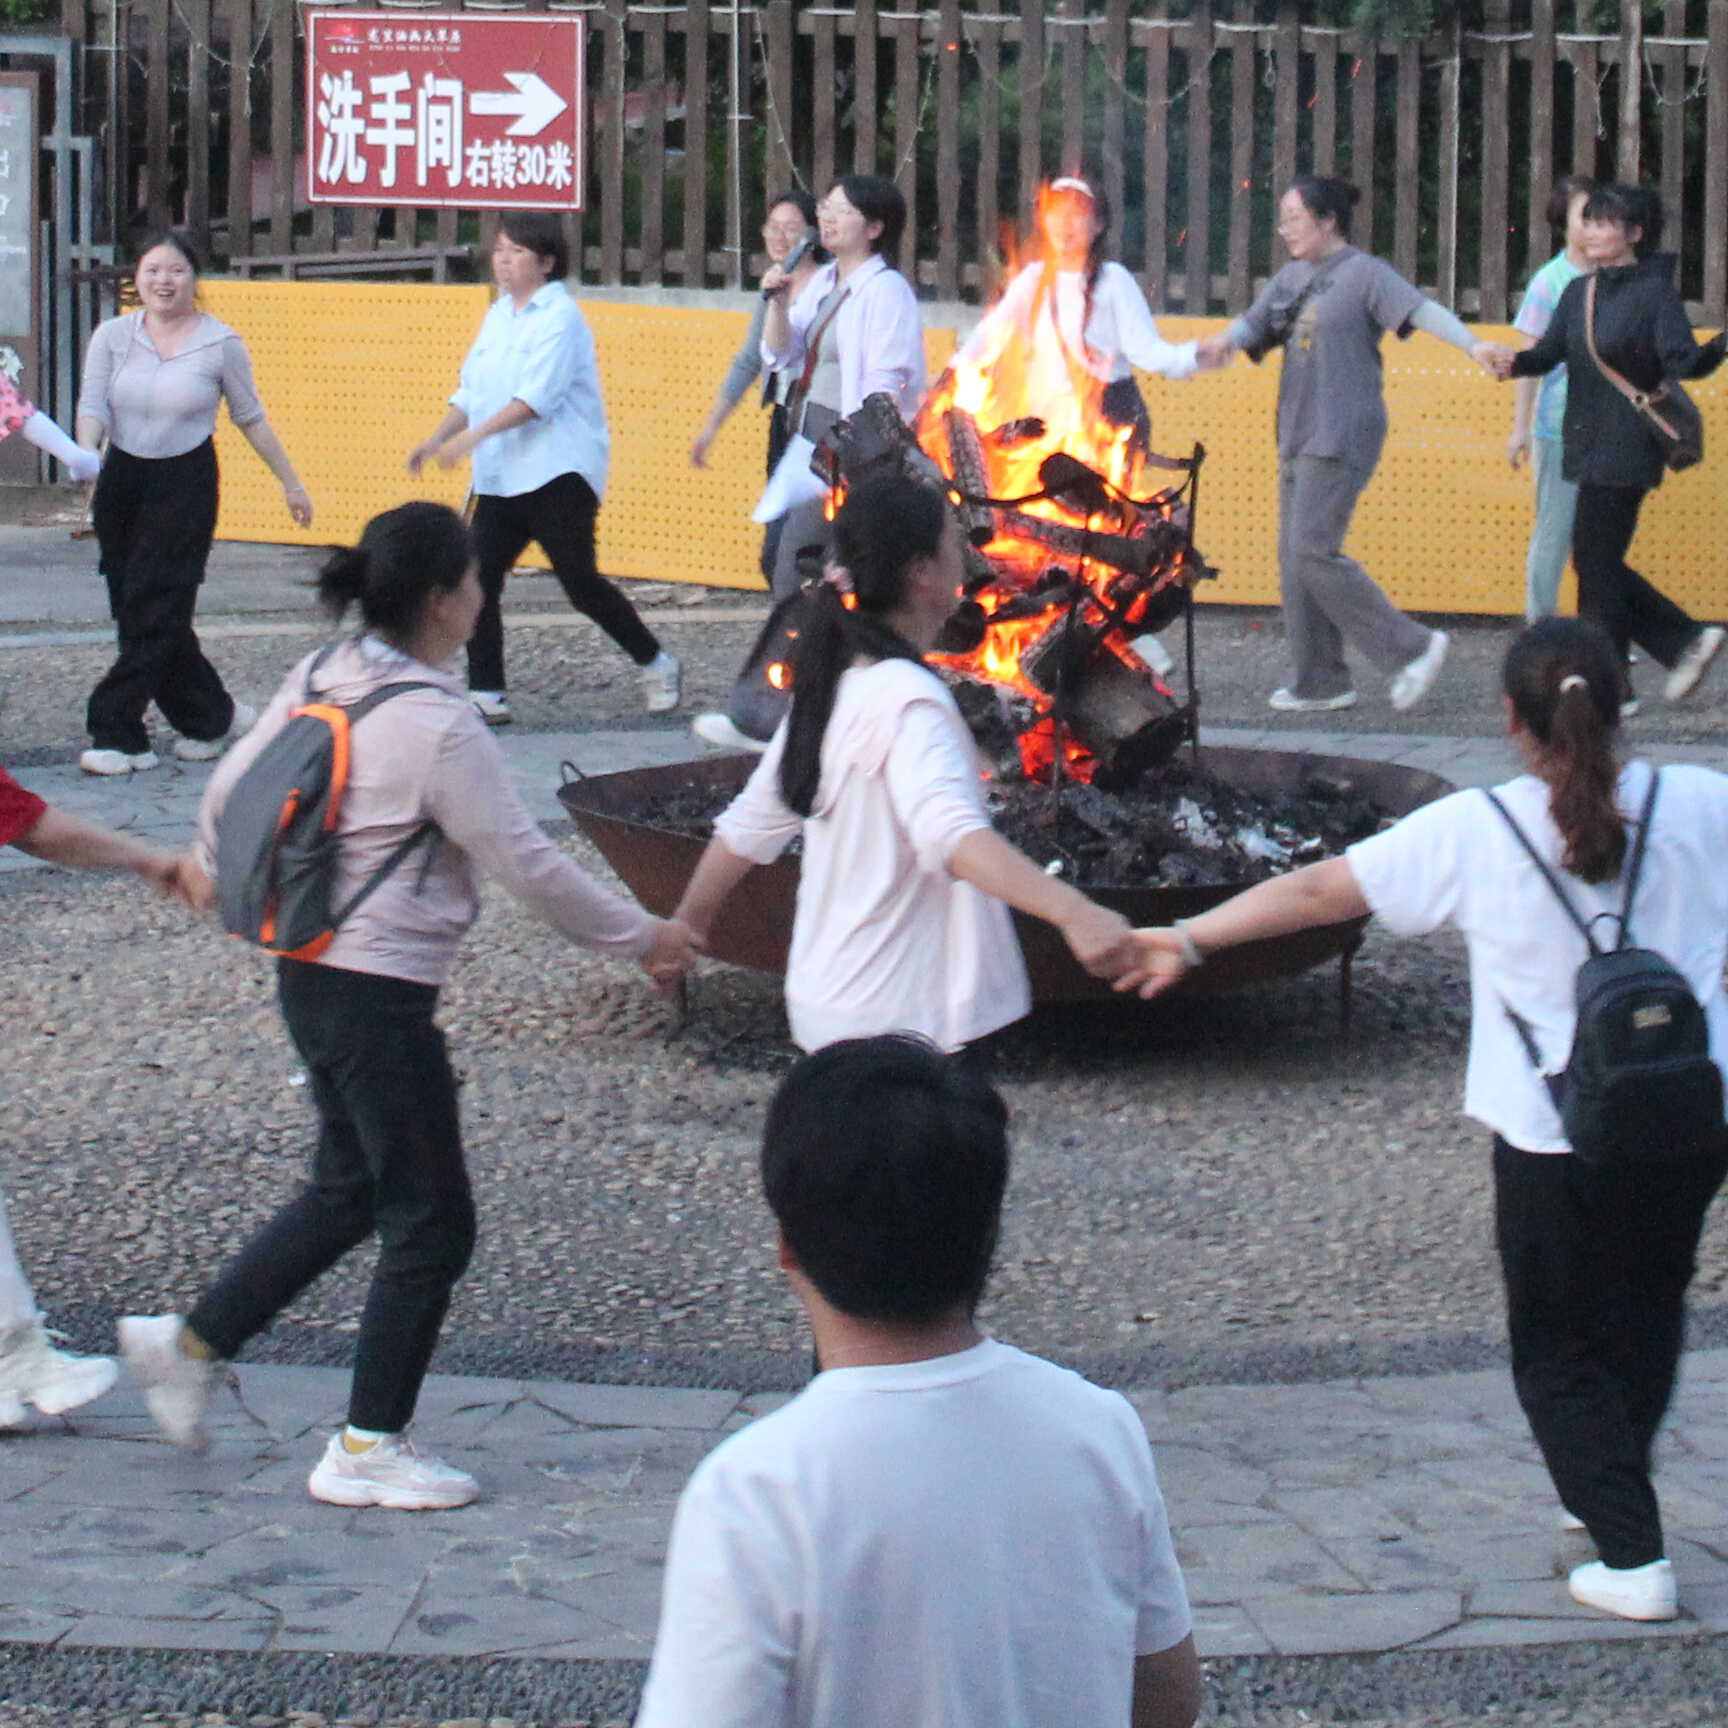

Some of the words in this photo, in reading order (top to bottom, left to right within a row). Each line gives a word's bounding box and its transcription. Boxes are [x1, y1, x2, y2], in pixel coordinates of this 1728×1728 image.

[317, 70, 464, 188] 洗手间
[466, 138, 573, 190] 右转30米
